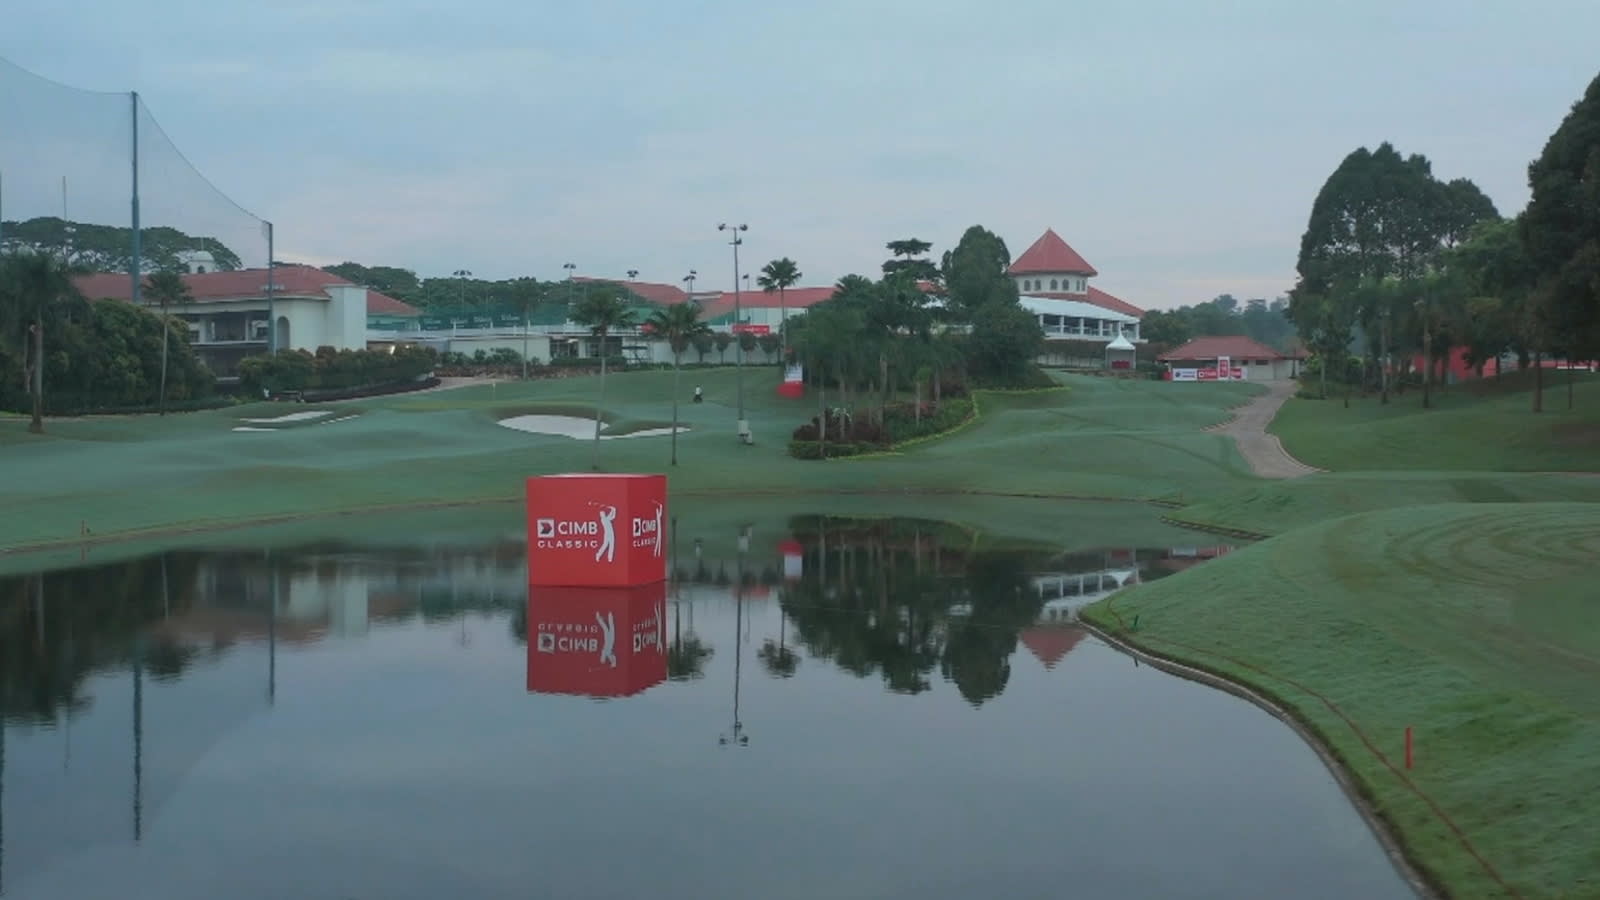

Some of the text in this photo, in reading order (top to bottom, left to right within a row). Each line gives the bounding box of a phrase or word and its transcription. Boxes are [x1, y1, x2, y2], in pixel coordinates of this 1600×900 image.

[557, 521, 598, 535] CIMB
[641, 519, 657, 533] CIMB
[537, 540, 599, 548] CLASSIC
